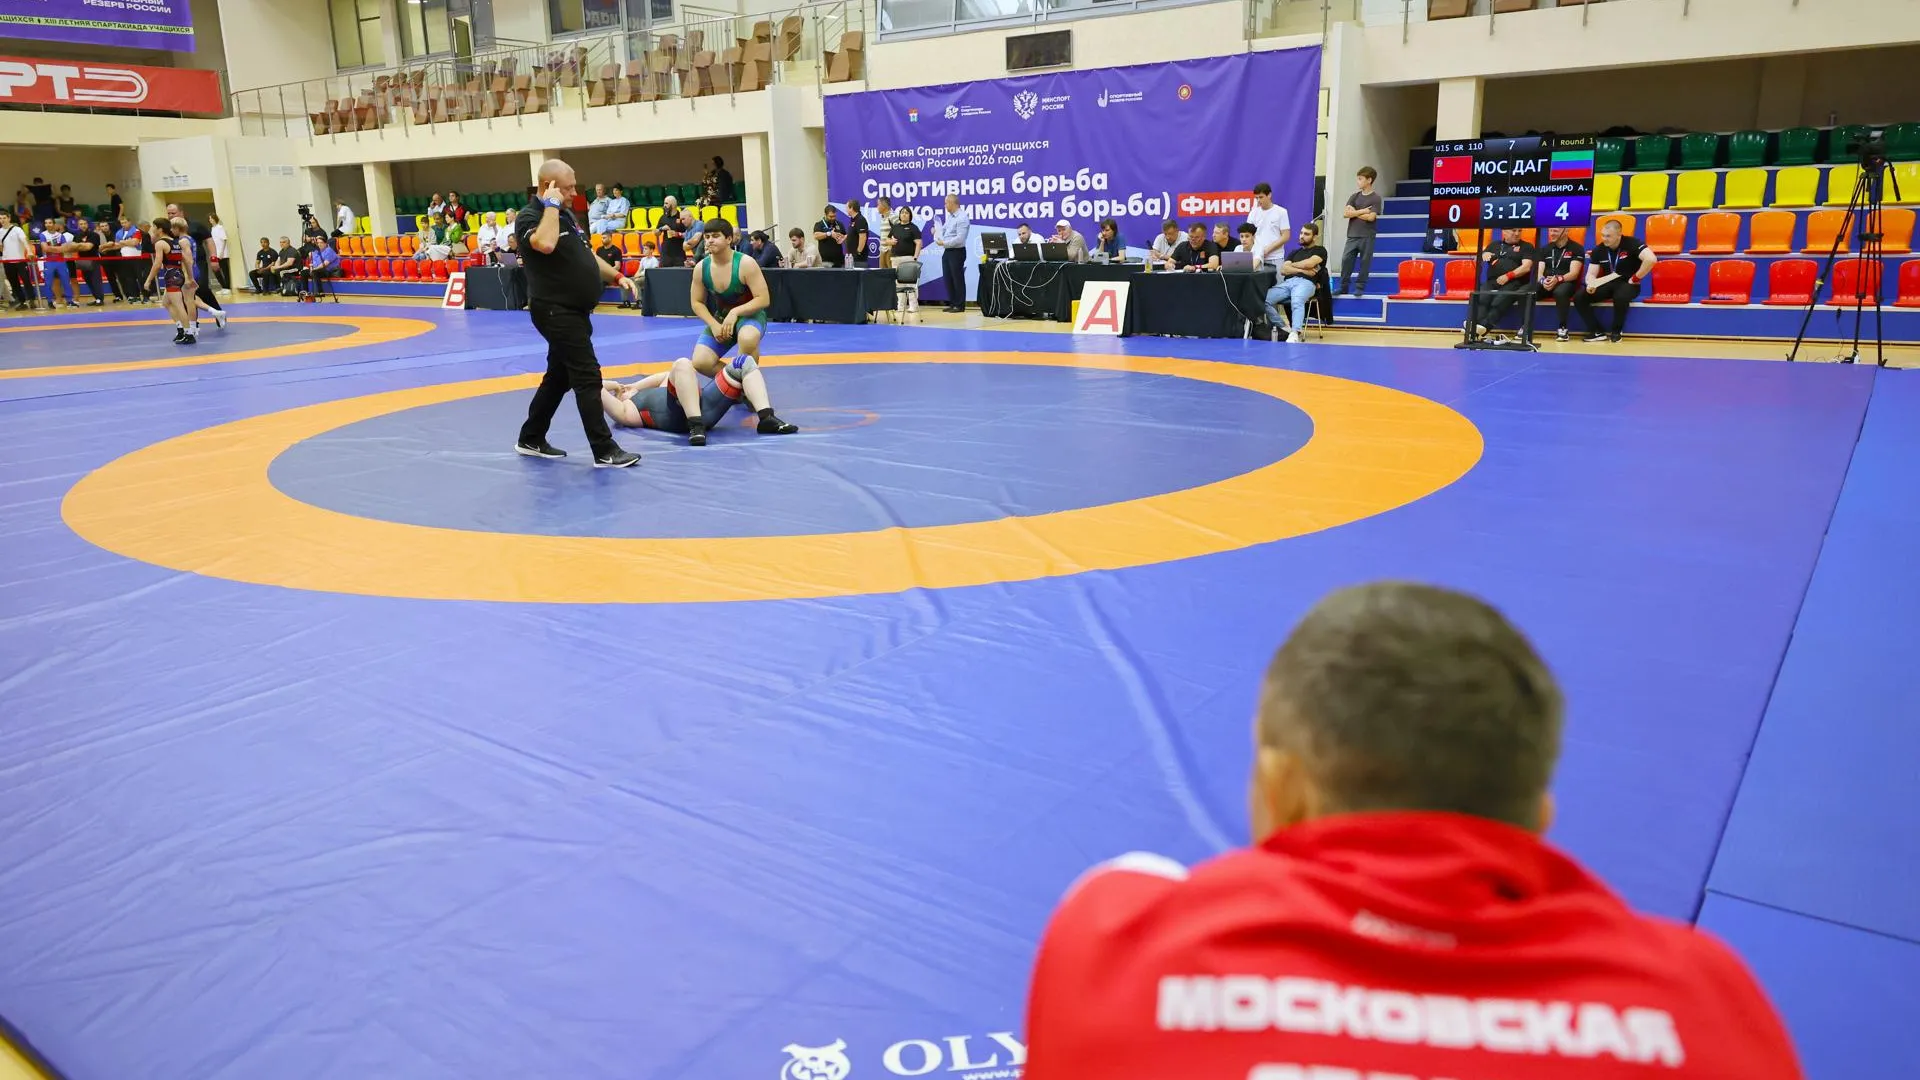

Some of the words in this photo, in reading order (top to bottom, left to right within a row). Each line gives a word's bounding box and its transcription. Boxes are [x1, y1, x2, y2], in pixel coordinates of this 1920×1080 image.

[83, 0, 124, 8] РЕЗЕРВ
[126, 3, 171, 13] РОССИИ
[92, 21, 147, 31] СПАРТАКИАДА
[149, 25, 190, 33] УЧАЩИХСЯ
[1042, 95, 1071, 103] МИНСПОРТ
[861, 149, 877, 160] XIII
[879, 149, 914, 158] летняя
[917, 144, 989, 157] Спартакиада
[991, 140, 1049, 154] учащихся
[1509, 140, 1515, 150] 7
[861, 159, 925, 173] (юношеская)
[927, 156, 966, 168] России
[968, 154, 995, 166] 2026
[998, 154, 1023, 166] года
[1474, 160, 1508, 175] МОС
[1512, 158, 1548, 176] ДАГ
[863, 177, 1005, 202] Спортивная
[1011, 167, 1108, 198] борьба
[1433, 186, 1481, 195] ВОРОНЦОВ
[1486, 185, 1497, 194] К.
[1508, 184, 1574, 194] УМАХАНДИБИРО
[1578, 184, 1588, 192] А.
[1061, 192, 1171, 222] борьба)
[1448, 204, 1461, 223] 0
[1483, 202, 1532, 220] 3:12
[1554, 201, 1569, 221] 4
[1081, 289, 1119, 332] A
[1156, 974, 1686, 1068] МОСКОВСКАЯ
